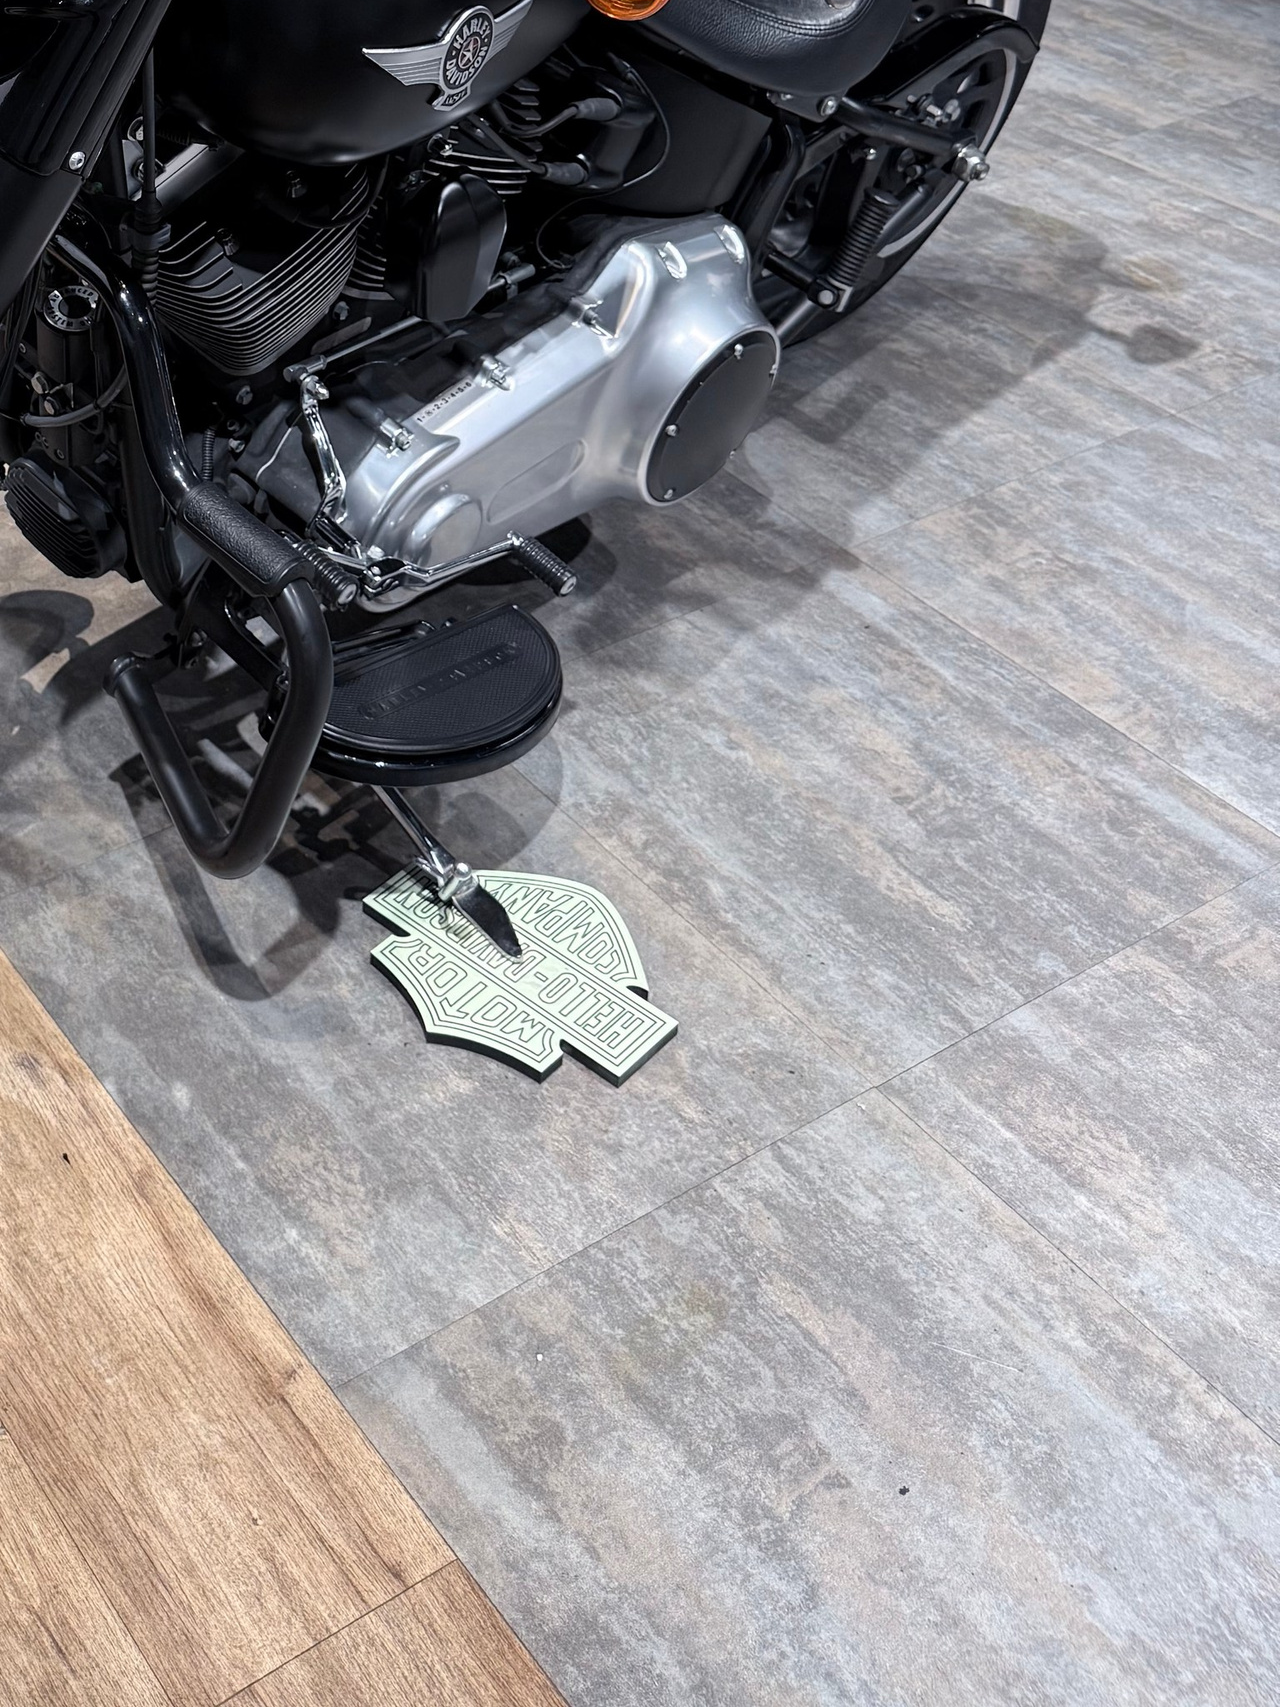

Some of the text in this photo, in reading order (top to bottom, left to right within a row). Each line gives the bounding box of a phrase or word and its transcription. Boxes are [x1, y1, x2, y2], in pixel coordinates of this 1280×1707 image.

[445, 45, 489, 85] DAVIDSON
[452, 17, 491, 50] HARLEY
[491, 882, 621, 975] COMPANY
[406, 941, 546, 1044] MOTOR
